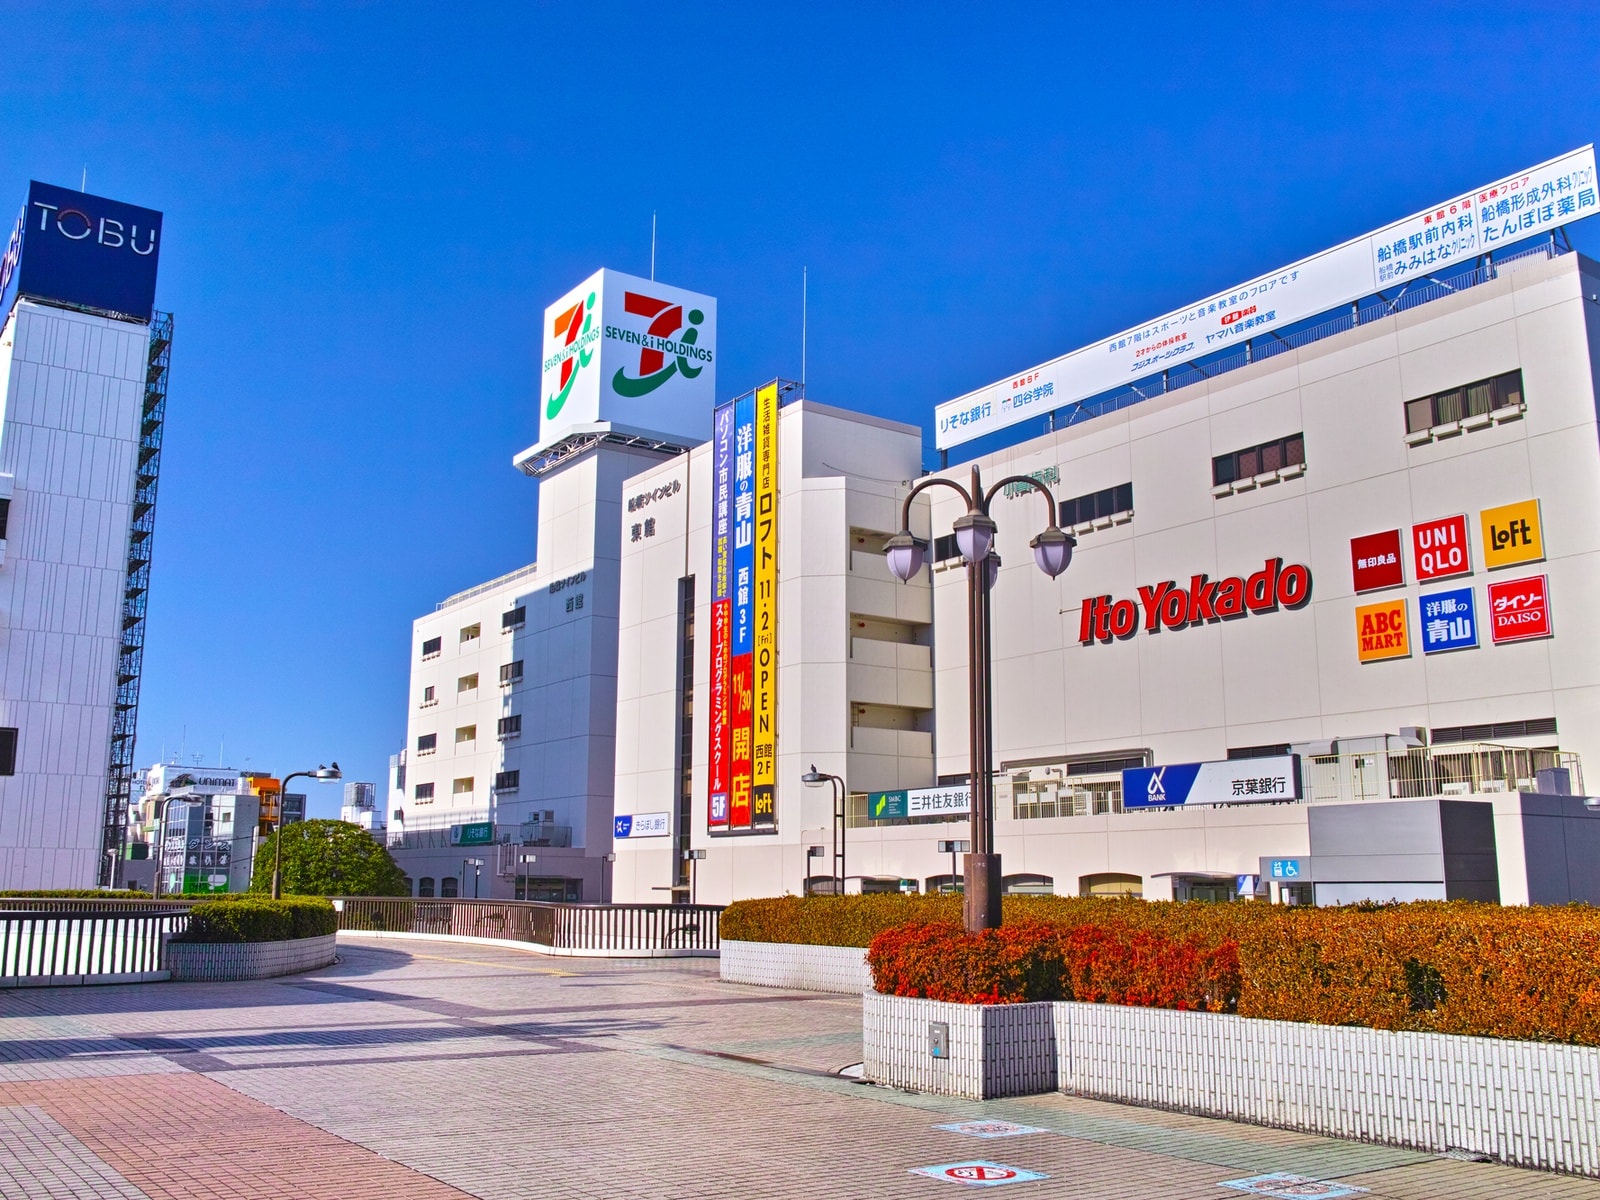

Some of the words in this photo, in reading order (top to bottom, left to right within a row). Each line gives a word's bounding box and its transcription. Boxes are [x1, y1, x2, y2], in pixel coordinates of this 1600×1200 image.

[33, 201, 156, 255] TOBU
[1484, 187, 1596, 242] たんぽぽ薬局
[1377, 212, 1473, 263] 船橋駅前内科
[1109, 271, 1299, 352] 西館7階はスポーツと音楽教室のフロアです
[1205, 310, 1276, 343] ヤマハ音楽教室
[544, 353, 562, 373] SEVEN
[569, 326, 600, 357] HOLDINGS
[605, 325, 640, 347] SEVEN
[641, 333, 649, 347] &
[650, 335, 654, 349] i
[656, 338, 713, 362] HOLDINGS
[1013, 382, 1054, 408] 四谷学院
[940, 401, 991, 433] りそな銀行
[718, 409, 730, 535] パソコン市民講座
[735, 423, 752, 549] 洋服の青山
[631, 517, 656, 543] 東館
[760, 493, 772, 570] ロフト
[1419, 524, 1457, 549] UNI
[1357, 552, 1397, 569] 無印良品
[1420, 547, 1462, 574] QLO
[1426, 598, 1468, 617] 洋服の
[1493, 593, 1543, 611] ダイソー
[1361, 609, 1402, 636] ABC
[1426, 617, 1471, 643] 青山
[1497, 610, 1541, 627] DAISO
[1362, 631, 1403, 652] MART
[713, 603, 724, 791] スタープログラミングスクール
[759, 648, 770, 733] OPEN
[755, 744, 772, 759] 西館
[731, 727, 751, 808] 開店
[757, 761, 771, 775] 2F
[198, 777, 235, 787] UNIMAT
[1231, 776, 1286, 796] 京葉銀行
[1147, 793, 1166, 802] BANK
